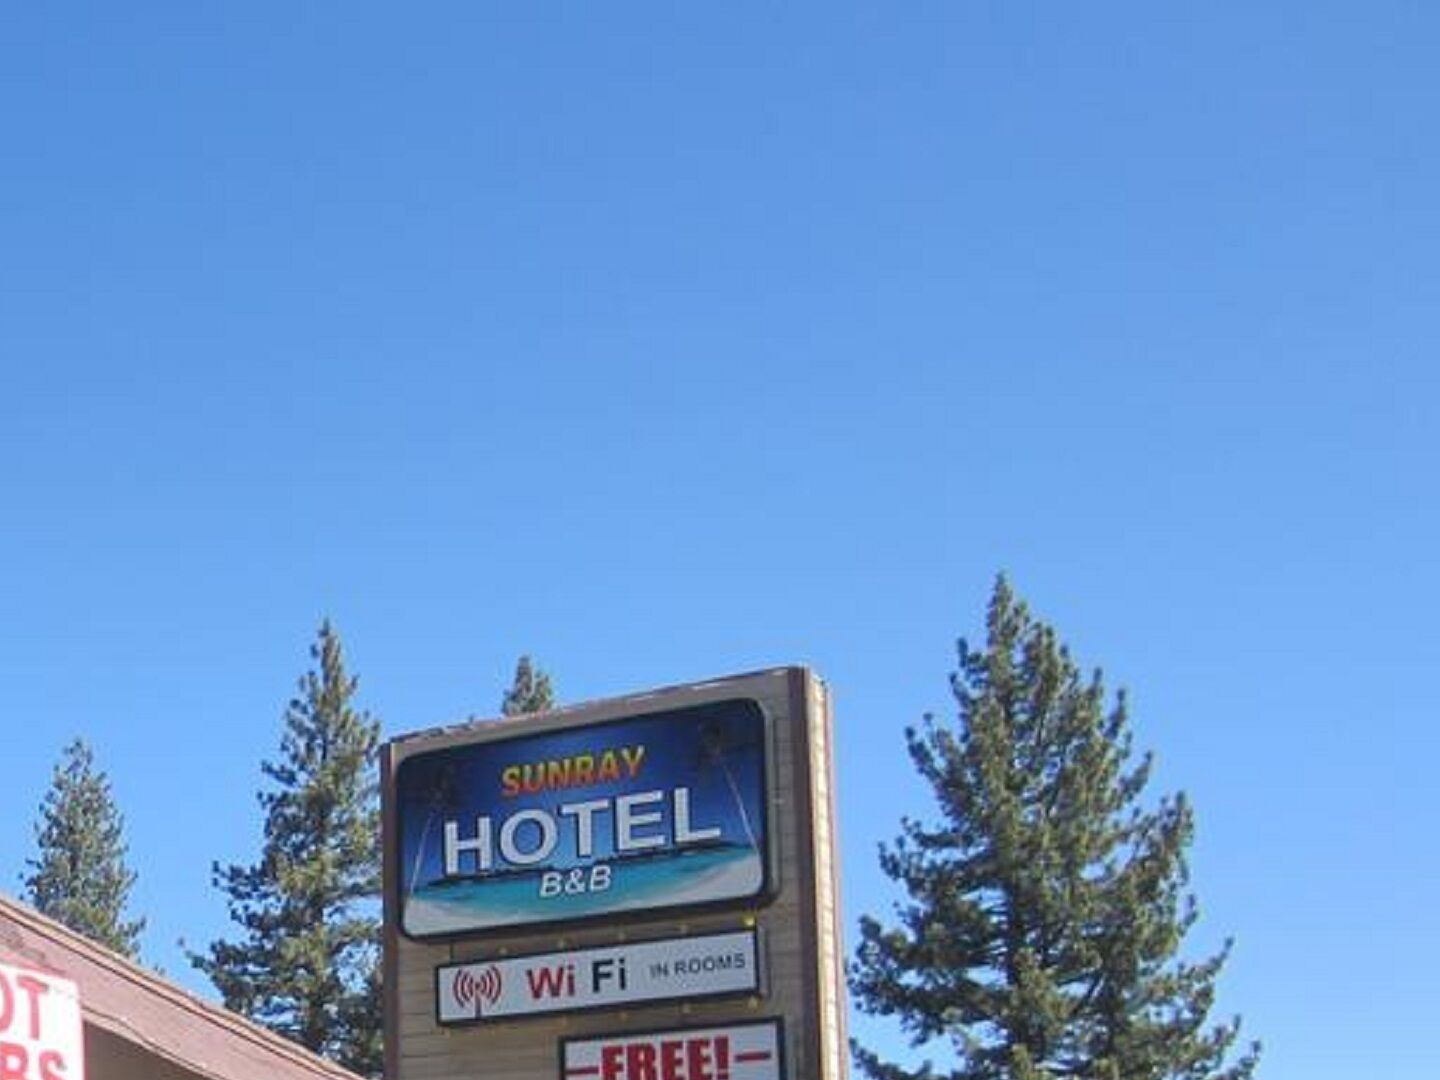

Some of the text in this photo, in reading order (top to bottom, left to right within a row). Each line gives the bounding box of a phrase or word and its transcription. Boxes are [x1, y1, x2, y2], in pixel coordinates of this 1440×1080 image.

[501, 745, 644, 797] SUNRAY
[443, 785, 721, 876] HOTEL
[539, 864, 612, 898] B&B
[527, 952, 747, 1000] Wi Fi IN ROOMS
